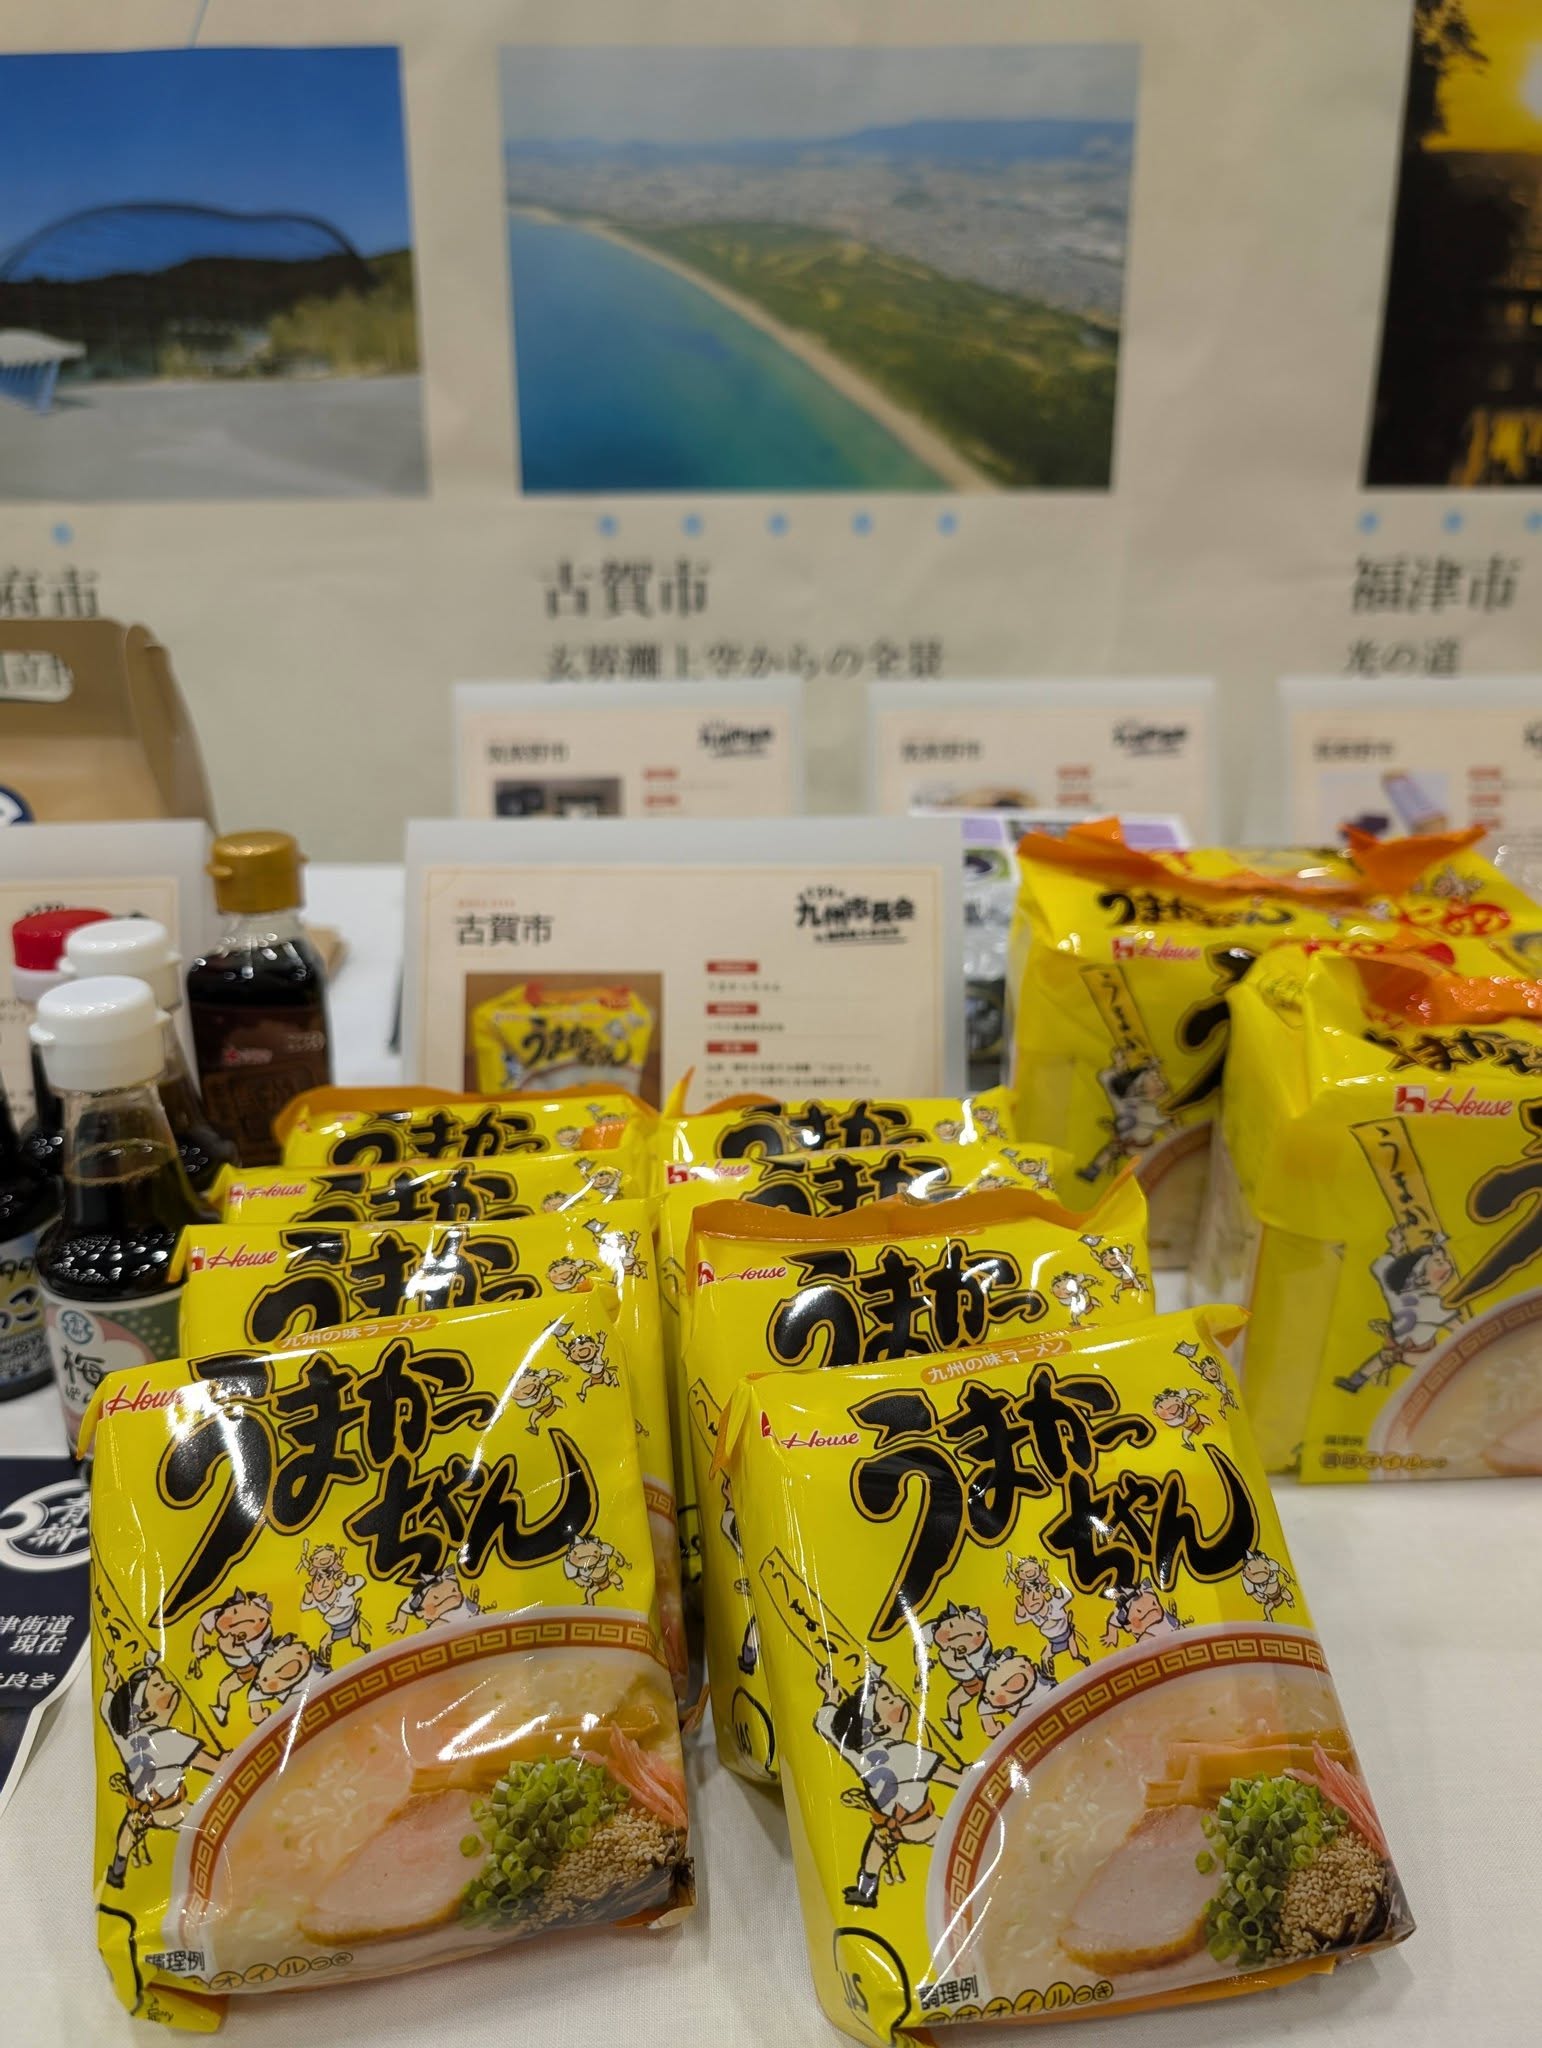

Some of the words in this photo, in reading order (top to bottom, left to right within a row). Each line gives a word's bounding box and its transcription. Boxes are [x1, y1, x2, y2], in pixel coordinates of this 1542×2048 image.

[542, 559, 710, 618] 古賀市
[456, 914, 553, 945] 古賀市
[1428, 1088, 1513, 1116] House
[246, 1181, 308, 1199] House
[208, 1243, 278, 1271] House
[281, 1317, 432, 1348] 九州の味ラーメン
[927, 1341, 1064, 1384] 九州の味ラーメン
[782, 1430, 860, 1449] House
[8, 1633, 68, 1655] 現在
[918, 1974, 980, 2011] 調理例
